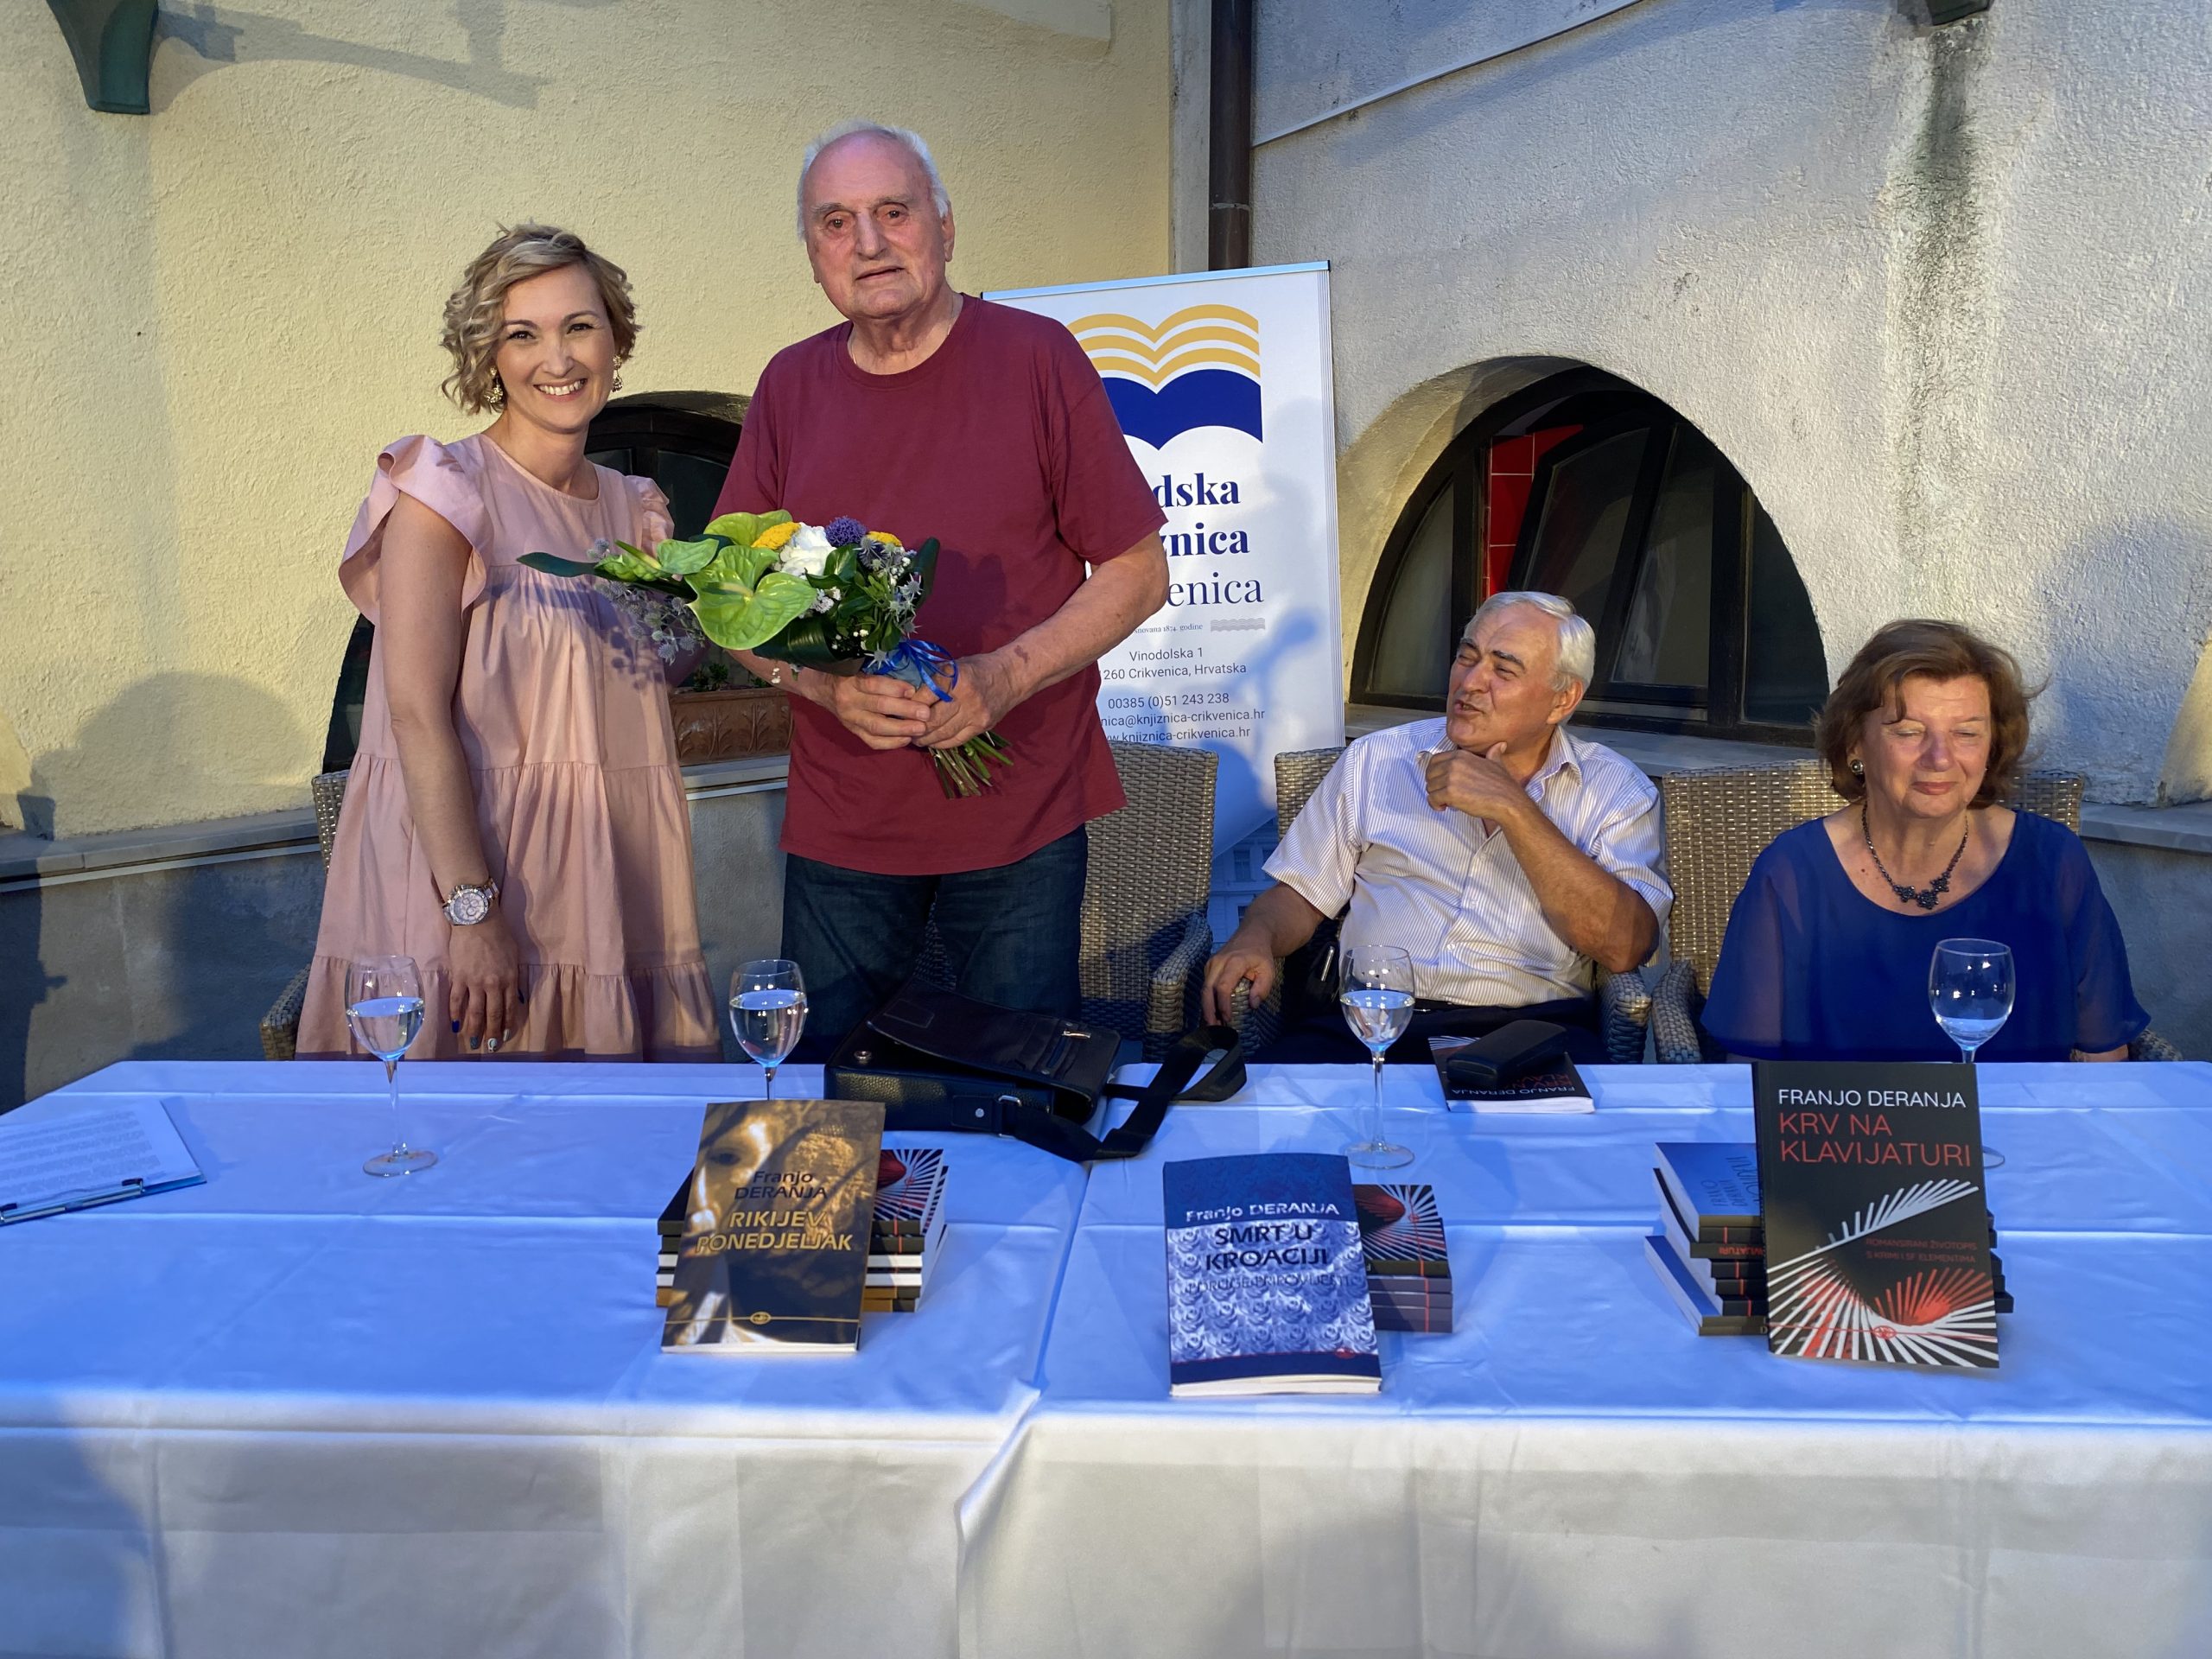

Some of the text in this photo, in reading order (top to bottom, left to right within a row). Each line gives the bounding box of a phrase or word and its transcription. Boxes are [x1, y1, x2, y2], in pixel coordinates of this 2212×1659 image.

[1153, 473, 1242, 508] dska
[1160, 523, 1250, 557] nica
[1166, 572, 1264, 607] enica
[1129, 647, 1204, 662] Vinodolska 1
[1100, 663, 1247, 680] 260 Crikvenica, Hrvatska
[1108, 693, 1230, 709] 00385 (0)51 243 238
[1101, 709, 1266, 728] nica@knjiznica-crikvenica.hr
[1519, 1086, 1575, 1095] FRANJO
[1778, 1089, 1967, 1109] FRANJO DERANJA
[1780, 1112, 1892, 1136] KRV NA
[1781, 1141, 1971, 1167] KLAVIJATURI
[753, 1171, 813, 1185] Franjo
[734, 1186, 828, 1199] DERANJA
[729, 1211, 827, 1228] RIKIJEV
[1186, 1202, 1340, 1222] Franjo DERANJA
[696, 1233, 854, 1253] PONEDJELJAK
[1214, 1224, 1313, 1245] SMRT U
[1205, 1248, 1328, 1271] KROACIJI
